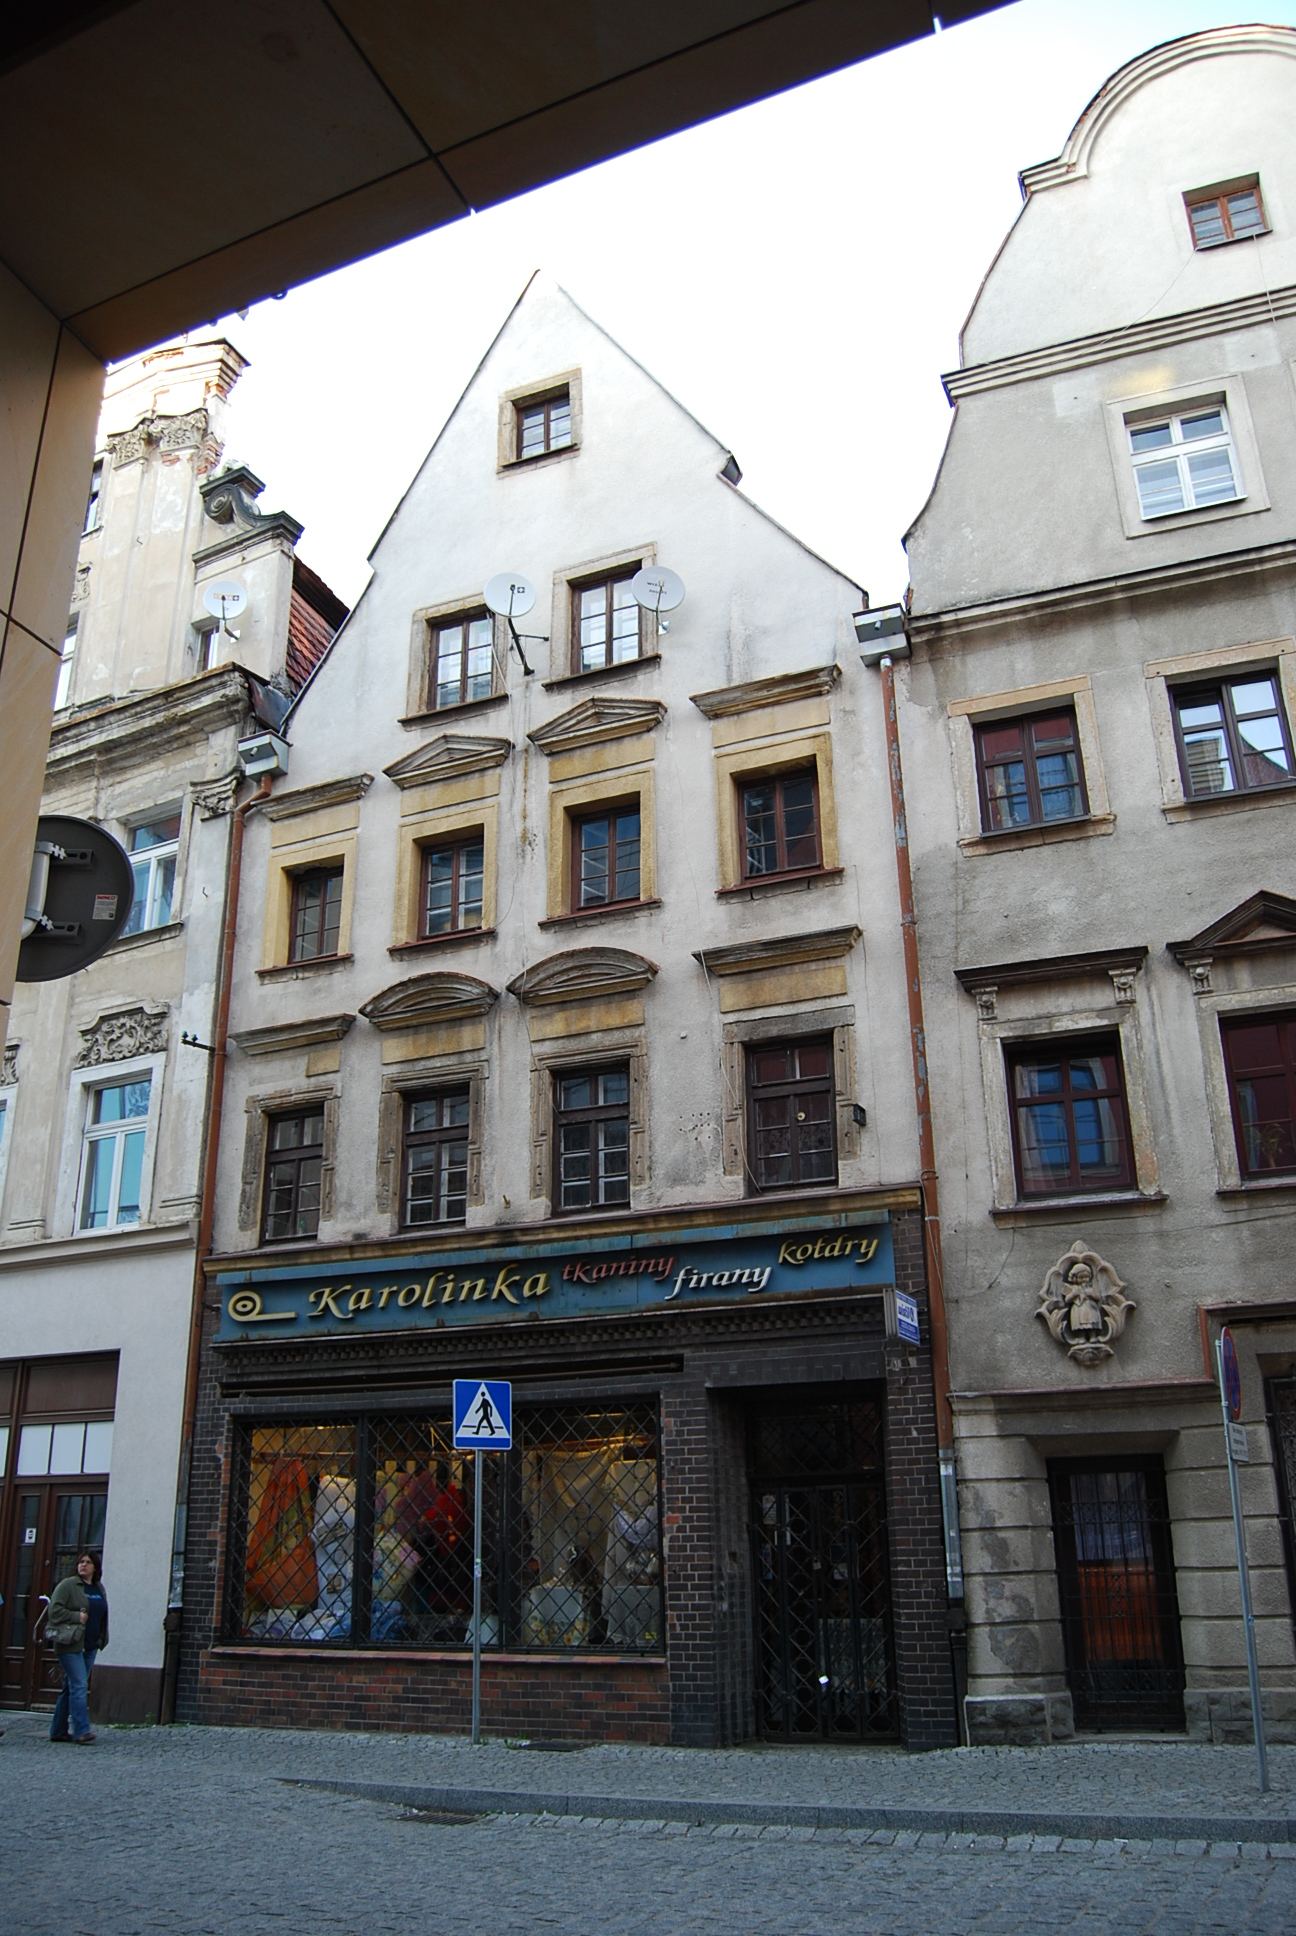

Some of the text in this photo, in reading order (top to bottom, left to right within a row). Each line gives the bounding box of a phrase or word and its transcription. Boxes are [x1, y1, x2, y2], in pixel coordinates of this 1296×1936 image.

[561, 1255, 676, 1284] tkaniny
[664, 1265, 772, 1300] firany
[306, 1263, 551, 1319] Karolinka
